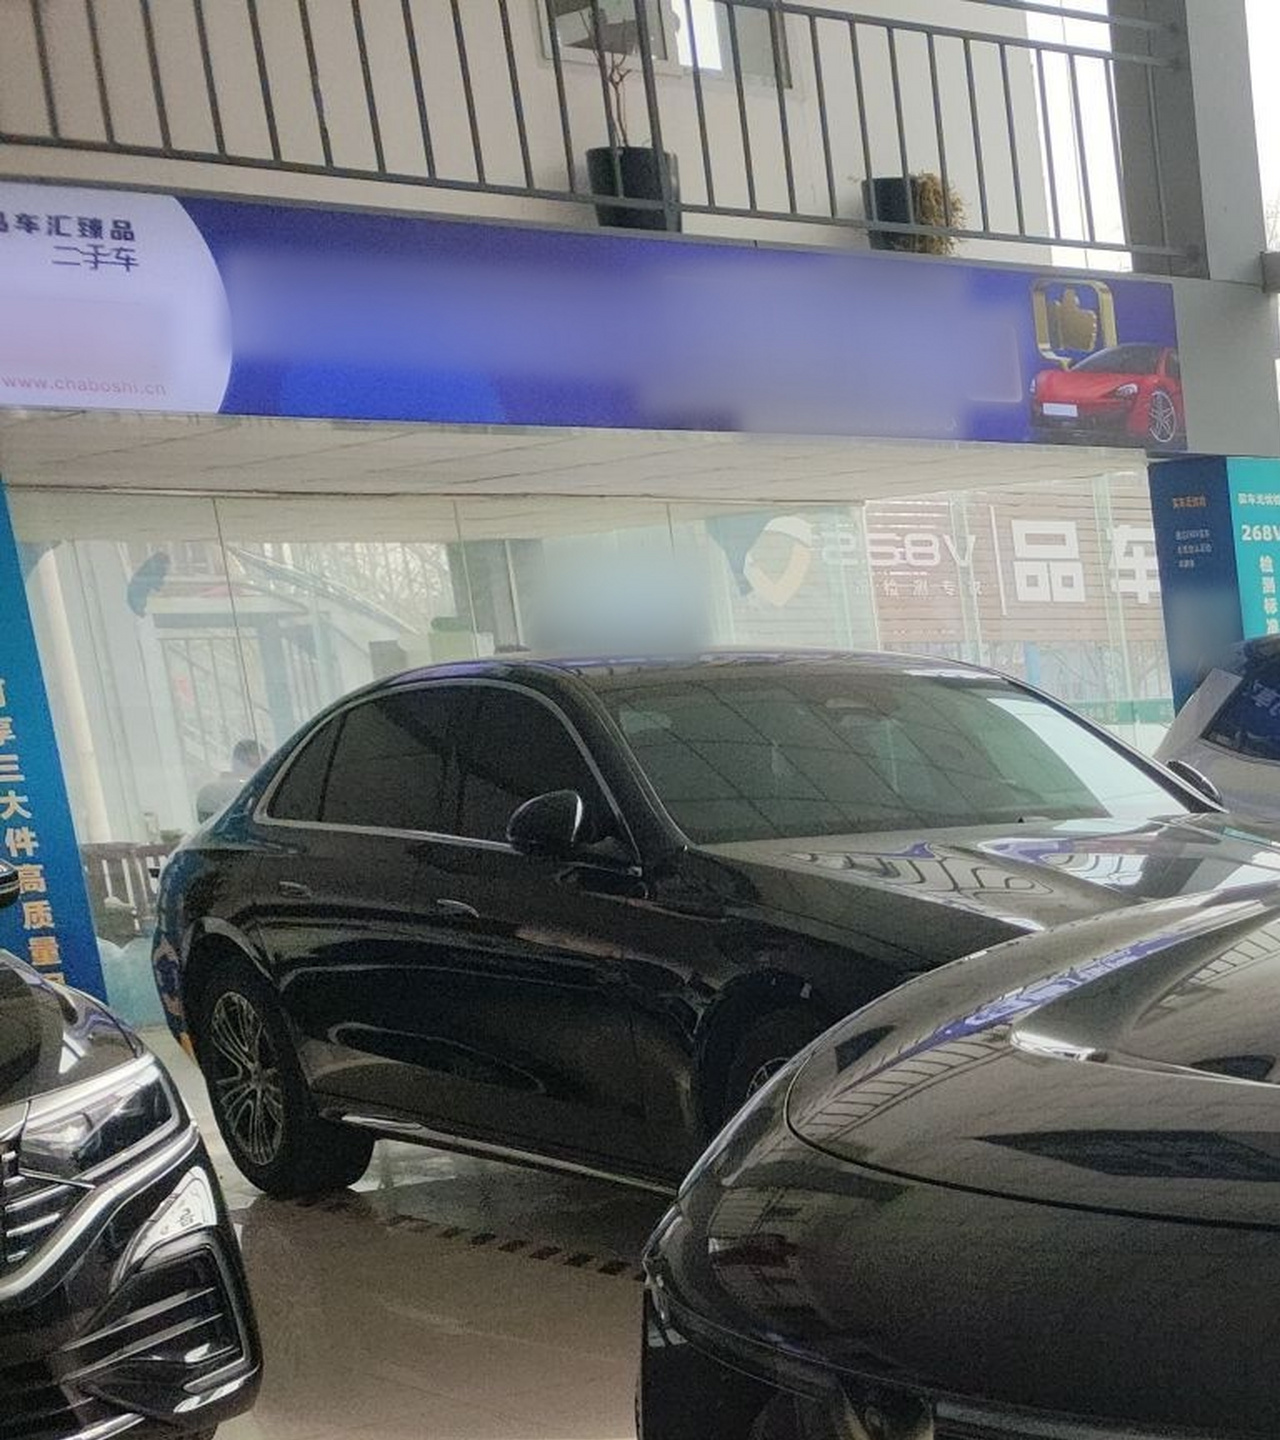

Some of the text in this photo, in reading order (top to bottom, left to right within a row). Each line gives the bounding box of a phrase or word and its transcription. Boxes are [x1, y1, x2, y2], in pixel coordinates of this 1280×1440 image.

[52, 243, 140, 272] 二手车
[1, 374, 167, 397] www.chaboshi.cn
